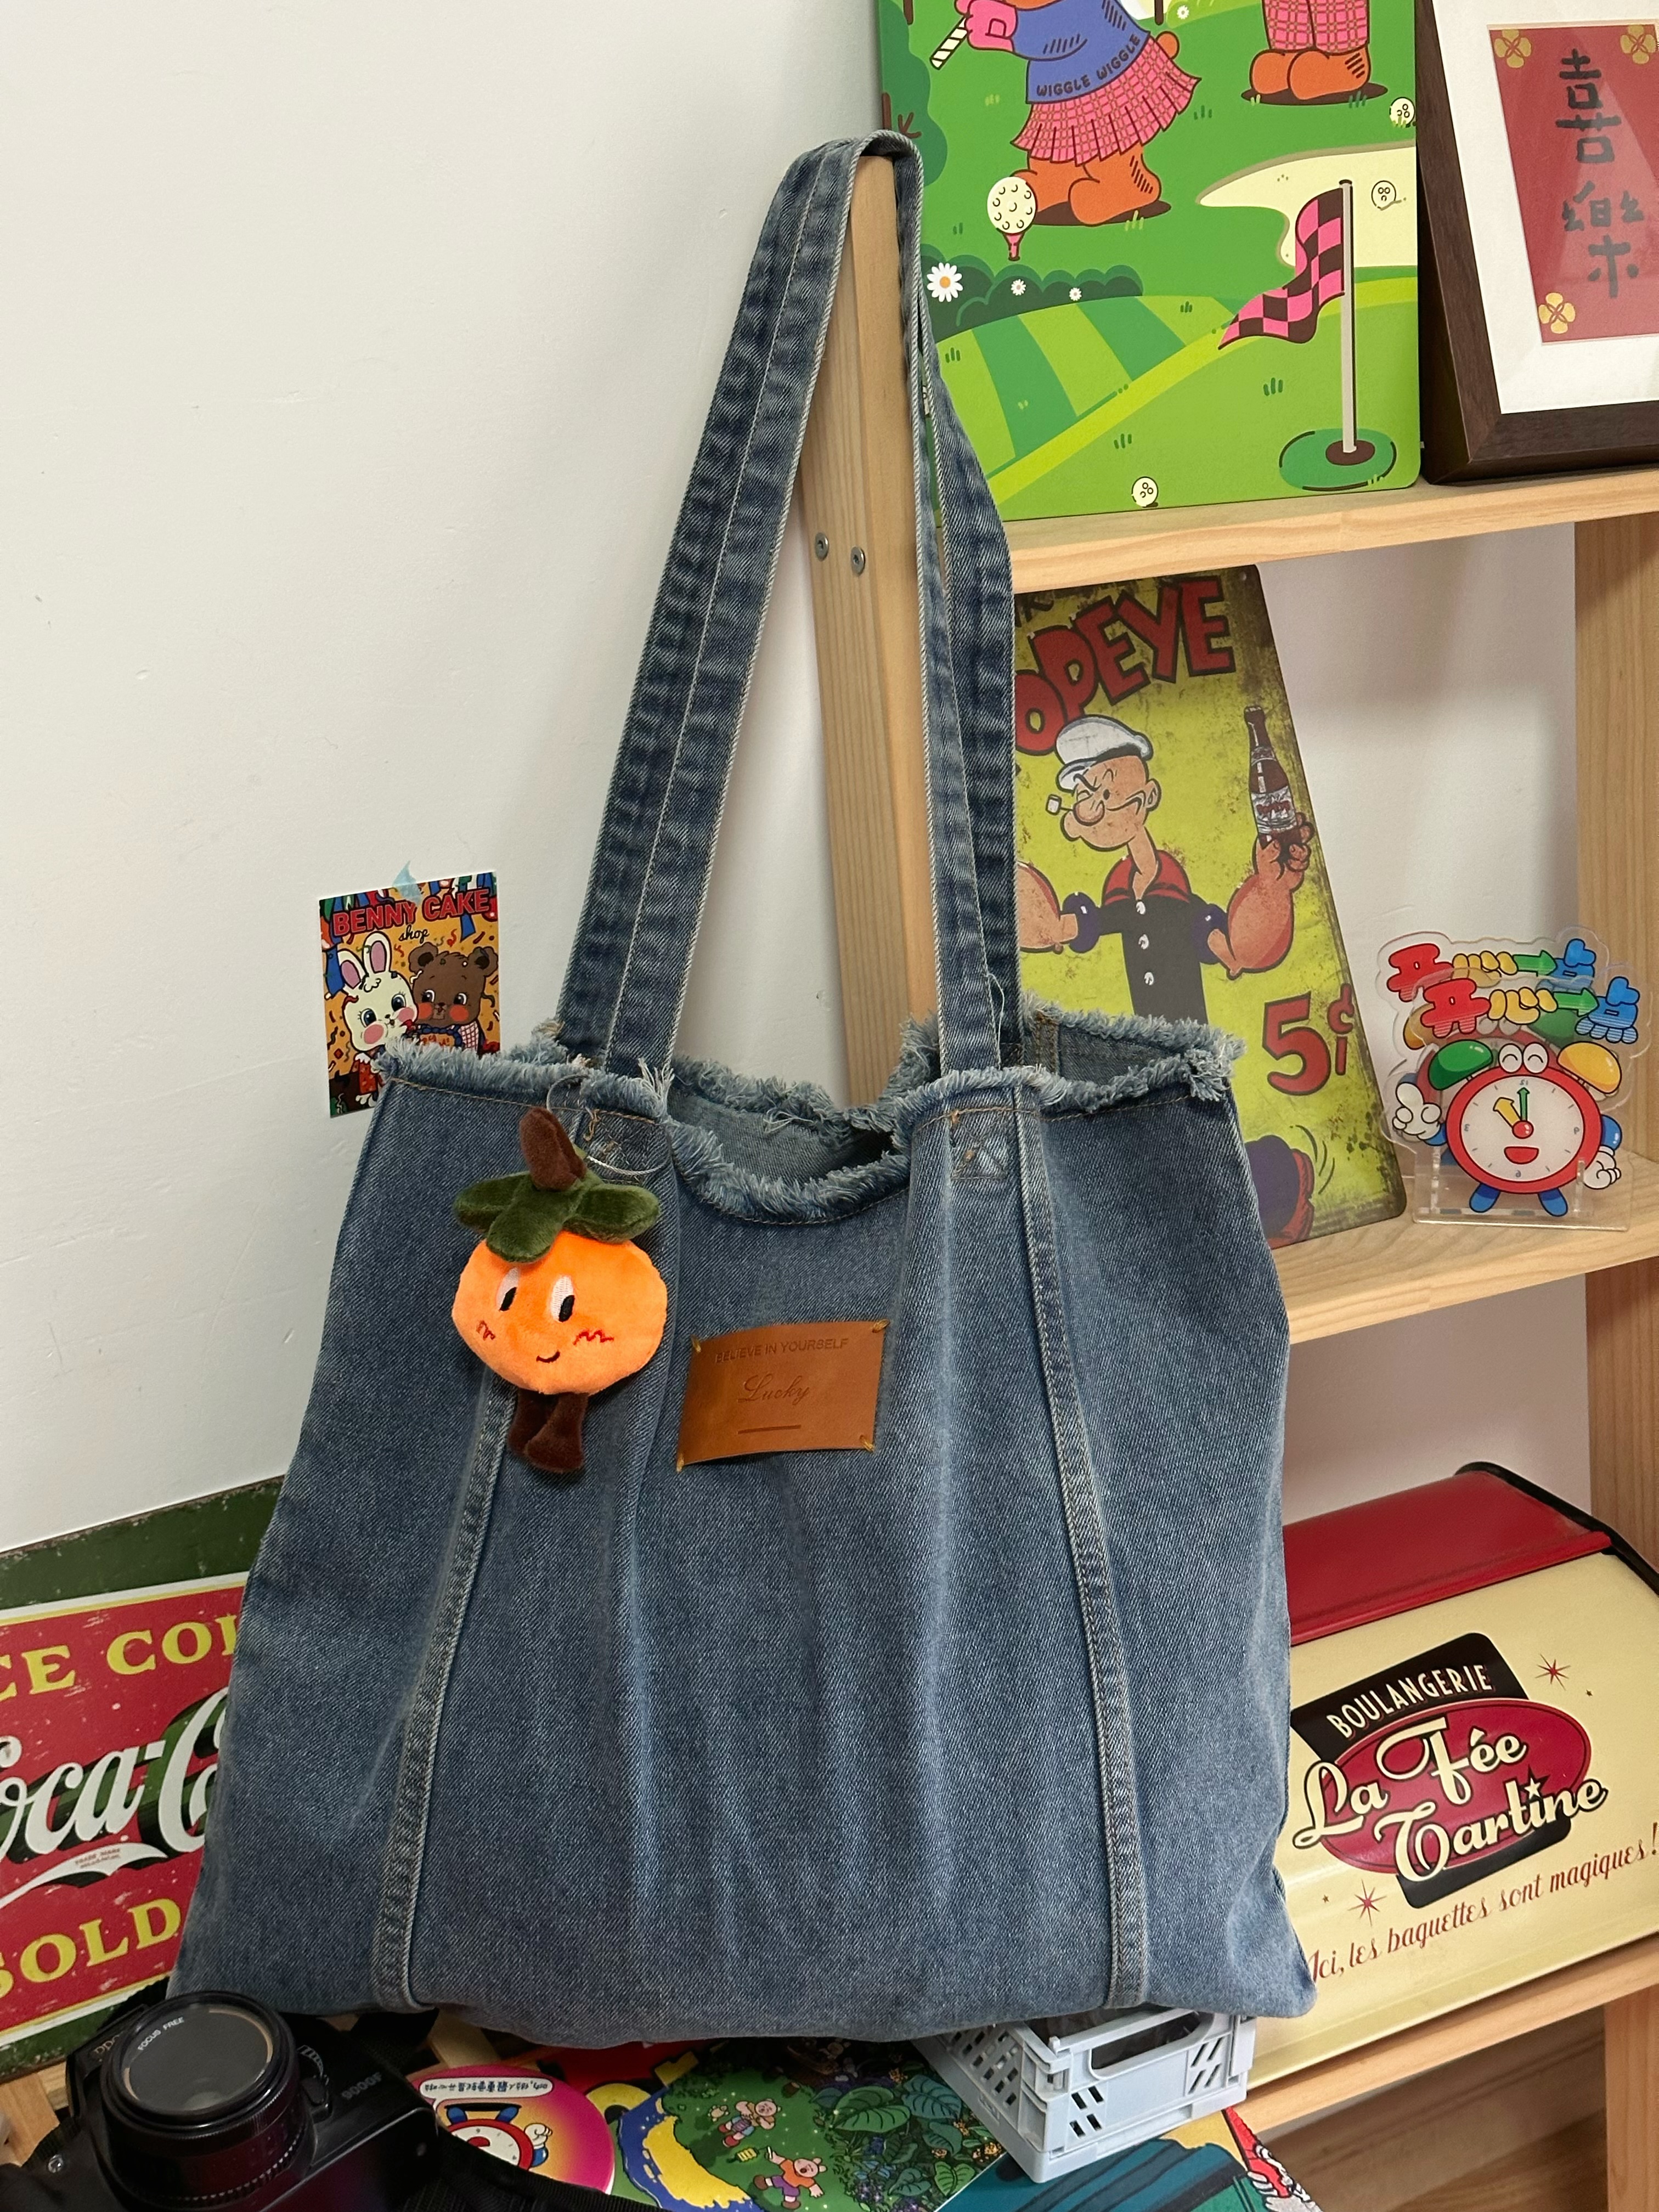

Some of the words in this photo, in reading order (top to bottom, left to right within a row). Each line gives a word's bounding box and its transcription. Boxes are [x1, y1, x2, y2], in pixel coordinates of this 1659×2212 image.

[1036, 76, 1091, 98] WIGGLE
[1096, 34, 1141, 80] WIGGLE
[1014, 575, 1237, 756] OPEYE
[332, 901, 417, 936] BENNY
[421, 889, 490, 922] CAKE
[398, 926, 430, 944] shop
[715, 1344, 761, 1364] BELIEVE
[765, 1342, 776, 1355] IN
[780, 1338, 849, 1353] YOURSELF
[737, 1373, 810, 1406] Lucky
[1327, 1664, 1494, 1738] BOULANGERIE
[1293, 1761, 1388, 1849] La
[1376, 1716, 1528, 1805] Fée
[1373, 1778, 1609, 1882] Tartine
[1348, 1938, 1378, 1967] les
[1387, 1897, 1491, 1954] baguettes
[1499, 1876, 1544, 1910] sont
[1549, 1838, 1647, 1889] magiques
[137, 2029, 161, 2051] FOCUS
[163, 2016, 185, 2030] FREE
